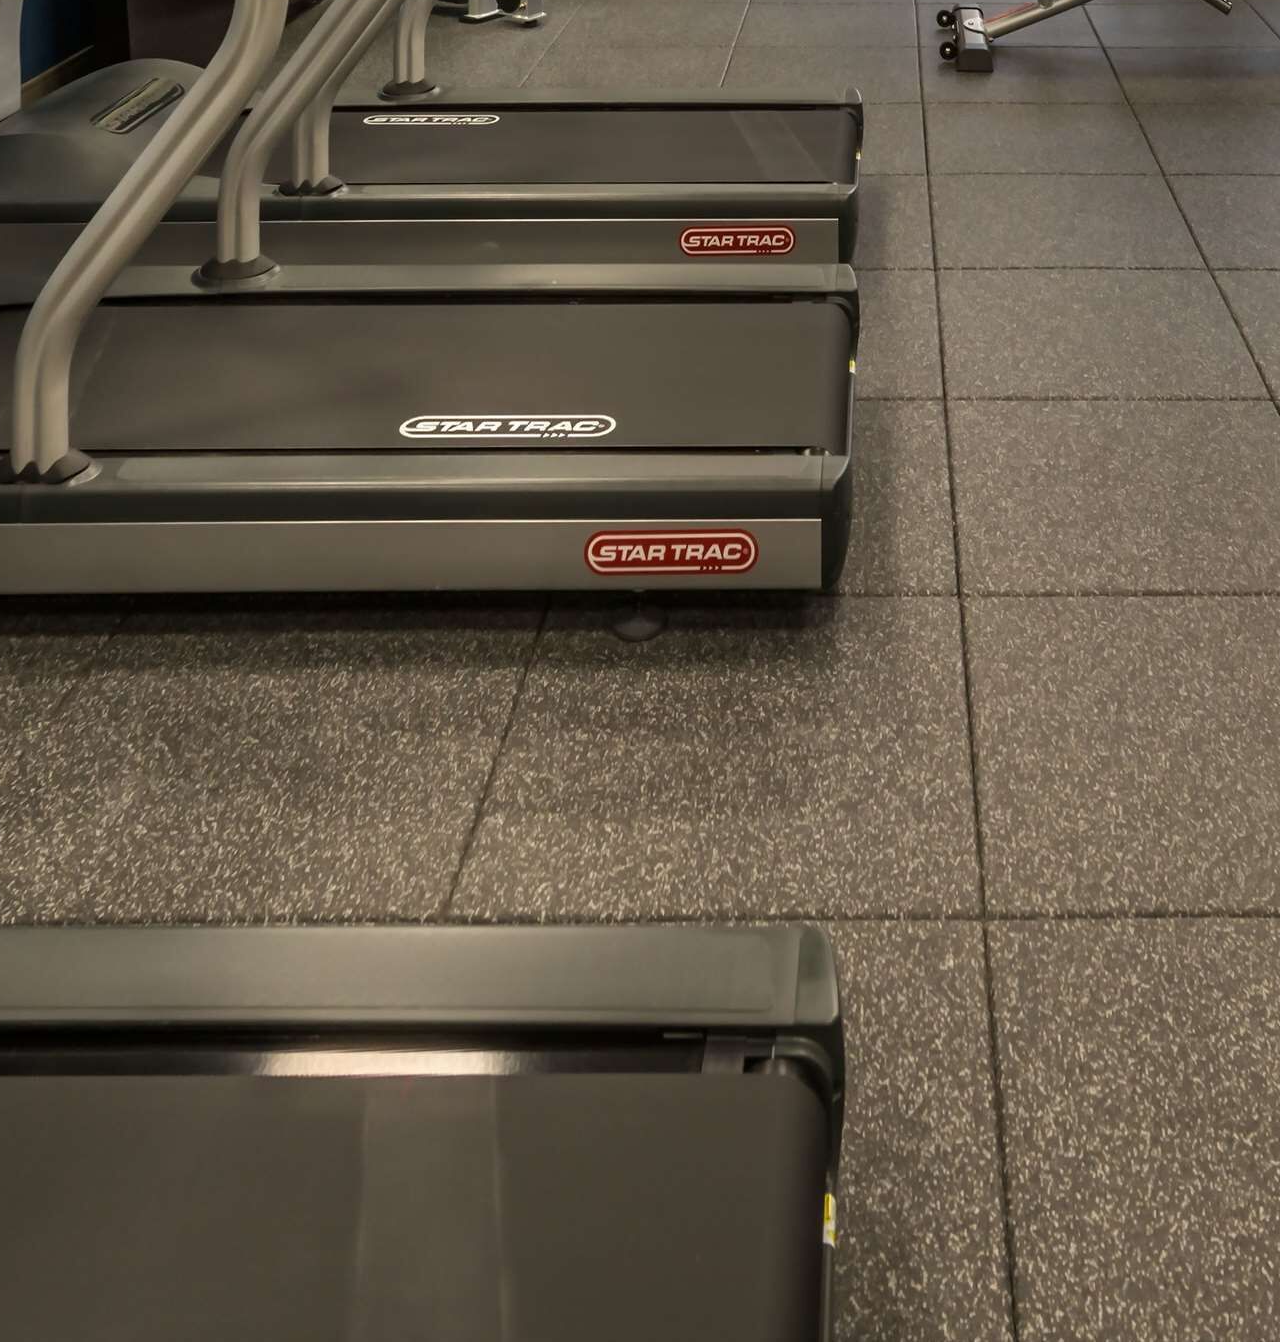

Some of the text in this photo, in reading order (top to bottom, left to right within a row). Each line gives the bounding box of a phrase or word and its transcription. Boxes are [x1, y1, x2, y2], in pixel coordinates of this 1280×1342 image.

[686, 235, 785, 247] STAR TRAC
[410, 420, 600, 433] STAR TRAC
[596, 543, 743, 562] STAR TRAC
